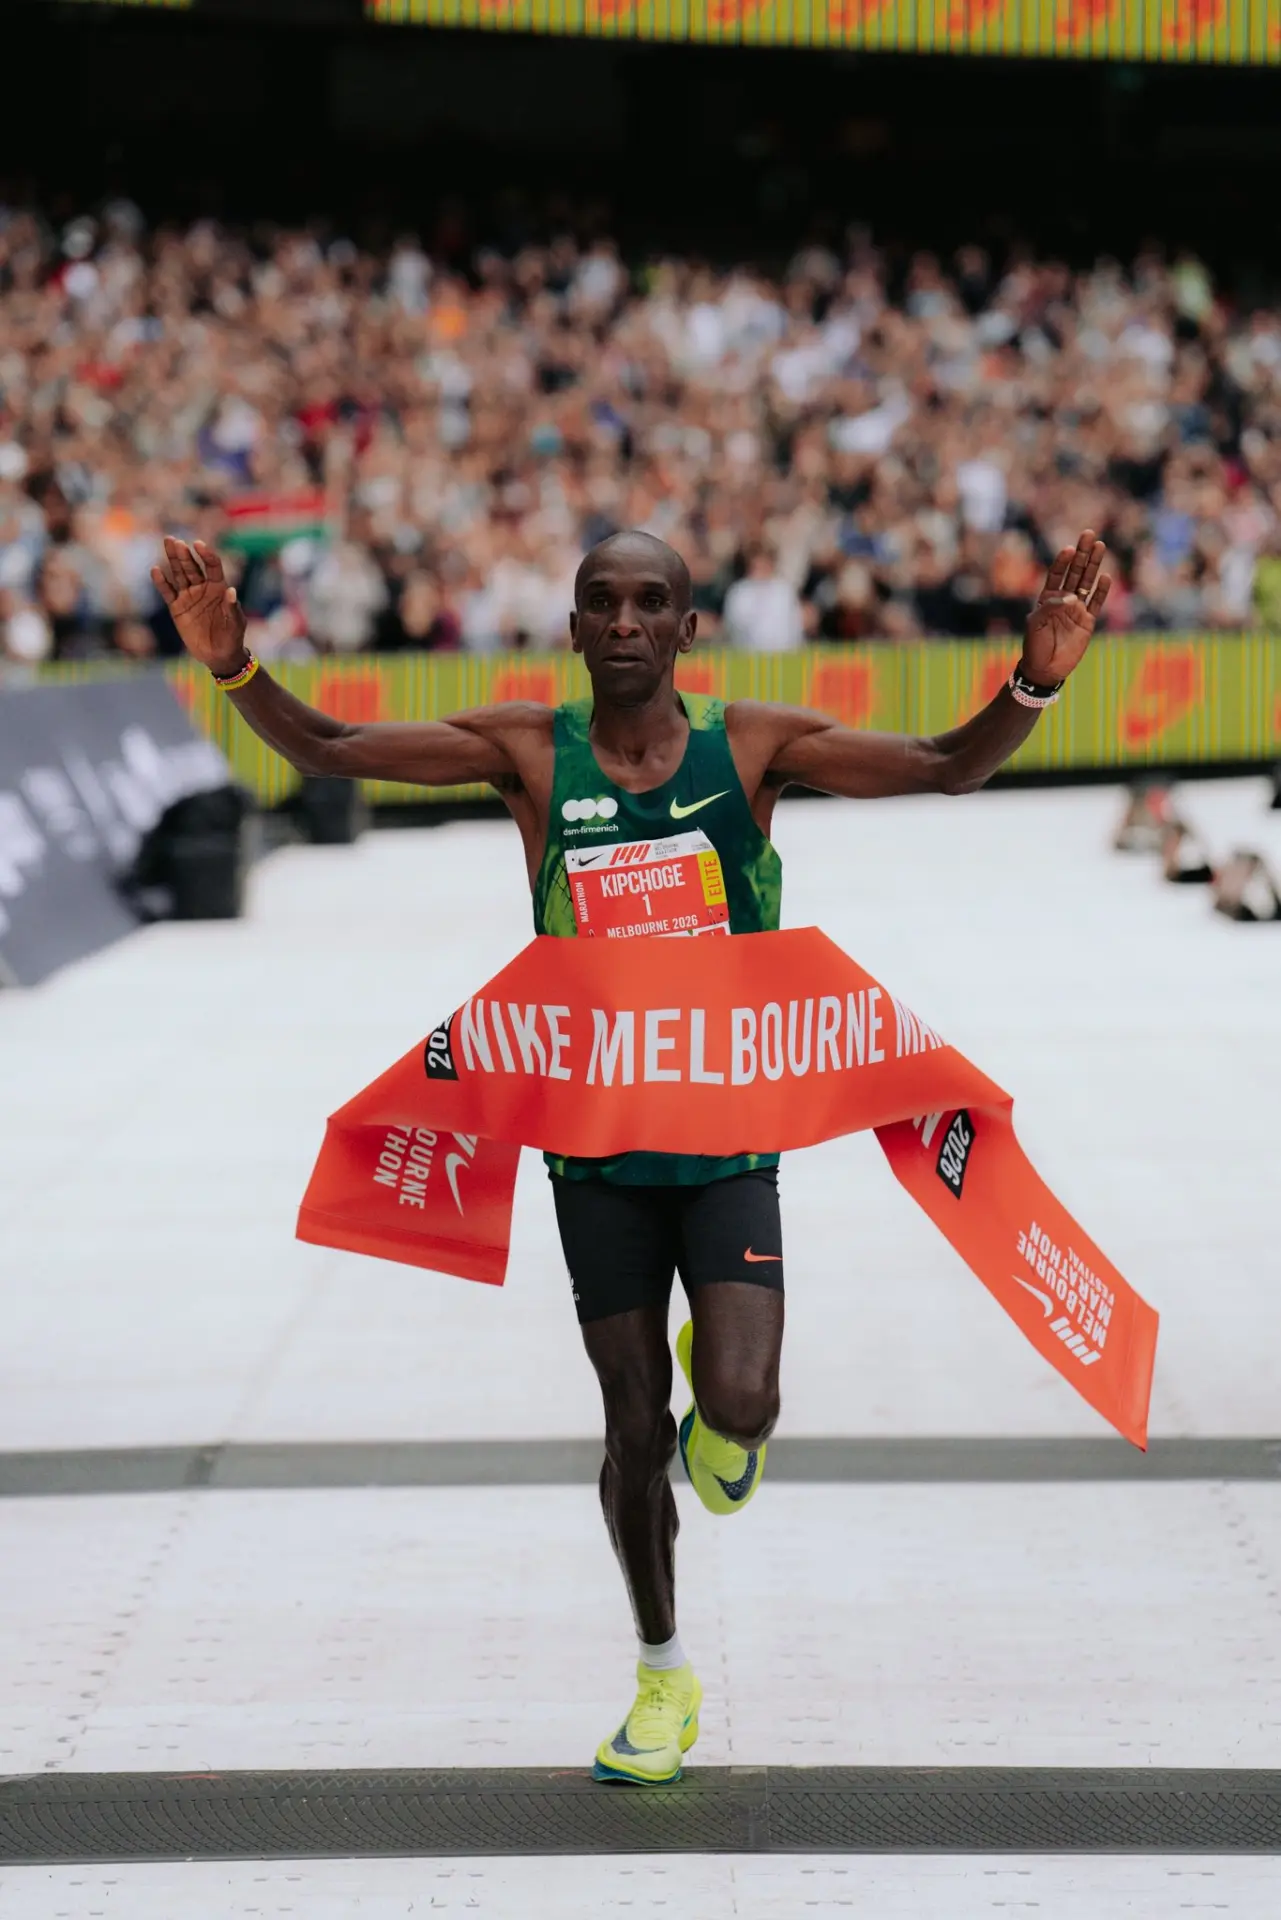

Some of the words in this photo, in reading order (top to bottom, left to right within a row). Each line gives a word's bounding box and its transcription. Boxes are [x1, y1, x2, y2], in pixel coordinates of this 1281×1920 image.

[563, 823, 619, 836] dsm-firmenich
[601, 864, 685, 897] KIPCHOGE
[704, 859, 722, 896] ELITE
[575, 882, 588, 922] MARATHON
[642, 893, 652, 916] 1
[607, 920, 668, 938] MELBOURNE
[673, 914, 698, 929] 2026
[459, 996, 571, 1081] NIKE
[586, 986, 886, 1087] MELBOURNE
[895, 998, 943, 1058] MA
[940, 1114, 970, 1186] 2026
[1016, 1230, 1107, 1348] MELBOURNE
[1029, 1221, 1112, 1327] MARATHON
[1068, 1246, 1115, 1307] FESTIVAL
